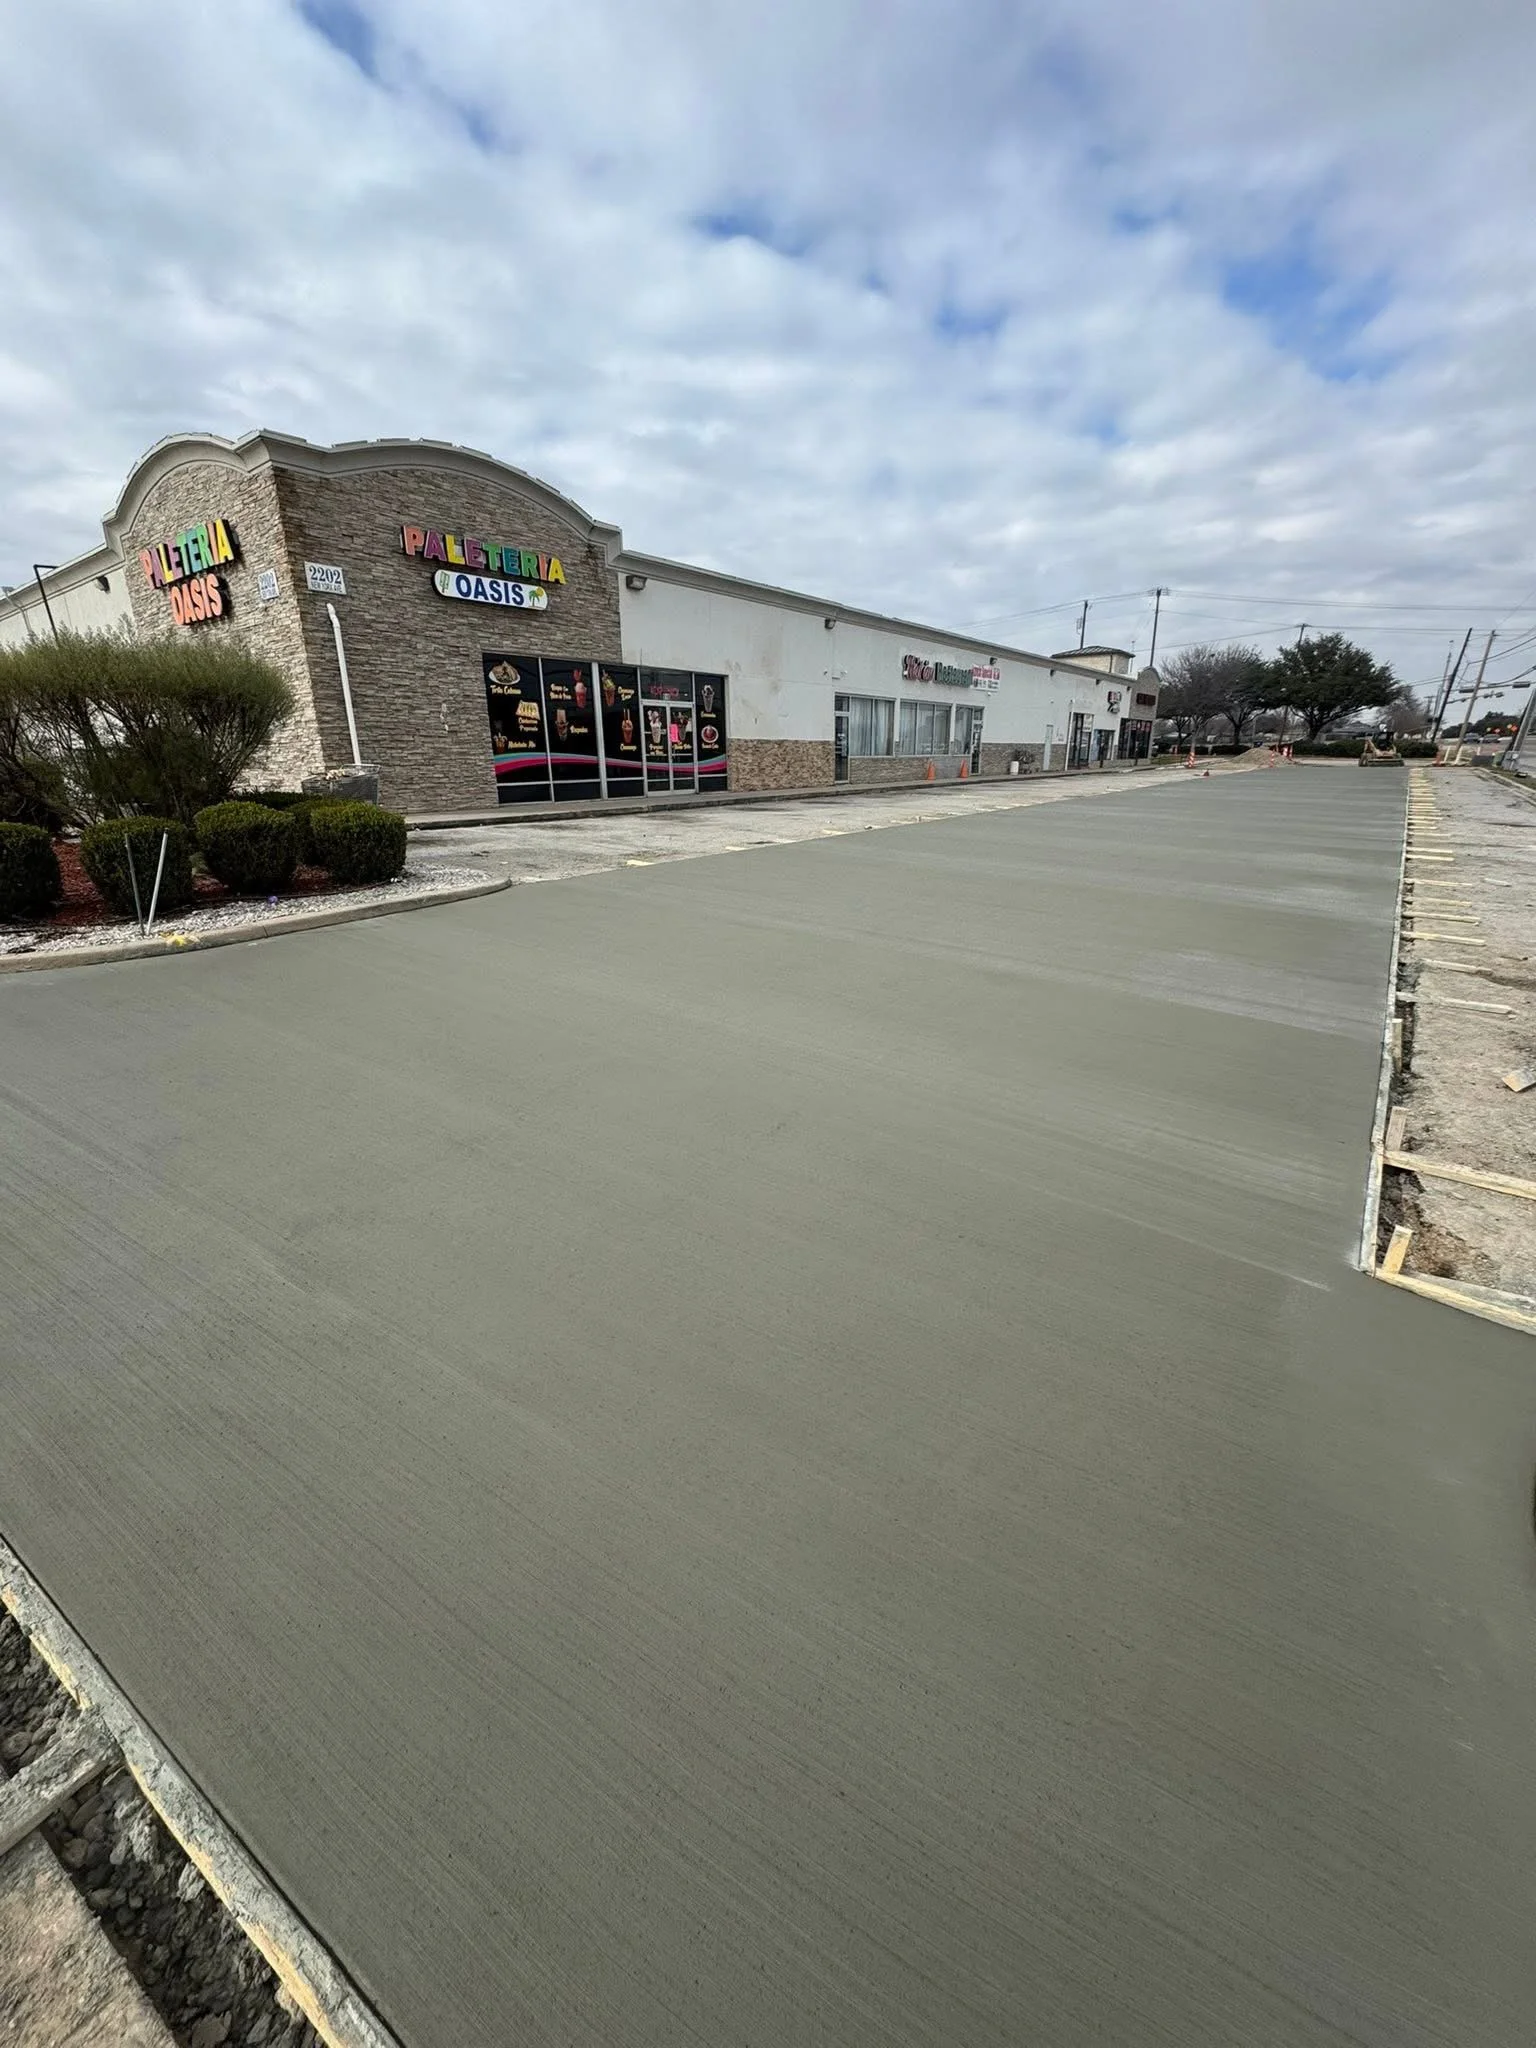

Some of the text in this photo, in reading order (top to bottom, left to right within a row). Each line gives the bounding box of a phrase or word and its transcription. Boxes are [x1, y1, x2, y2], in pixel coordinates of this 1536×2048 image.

[138, 518, 235, 589] PALETERIA
[309, 565, 342, 584] 2202
[401, 524, 568, 585] PALETERIA
[169, 573, 223, 625] OASIS
[455, 574, 525, 605] OASIS
